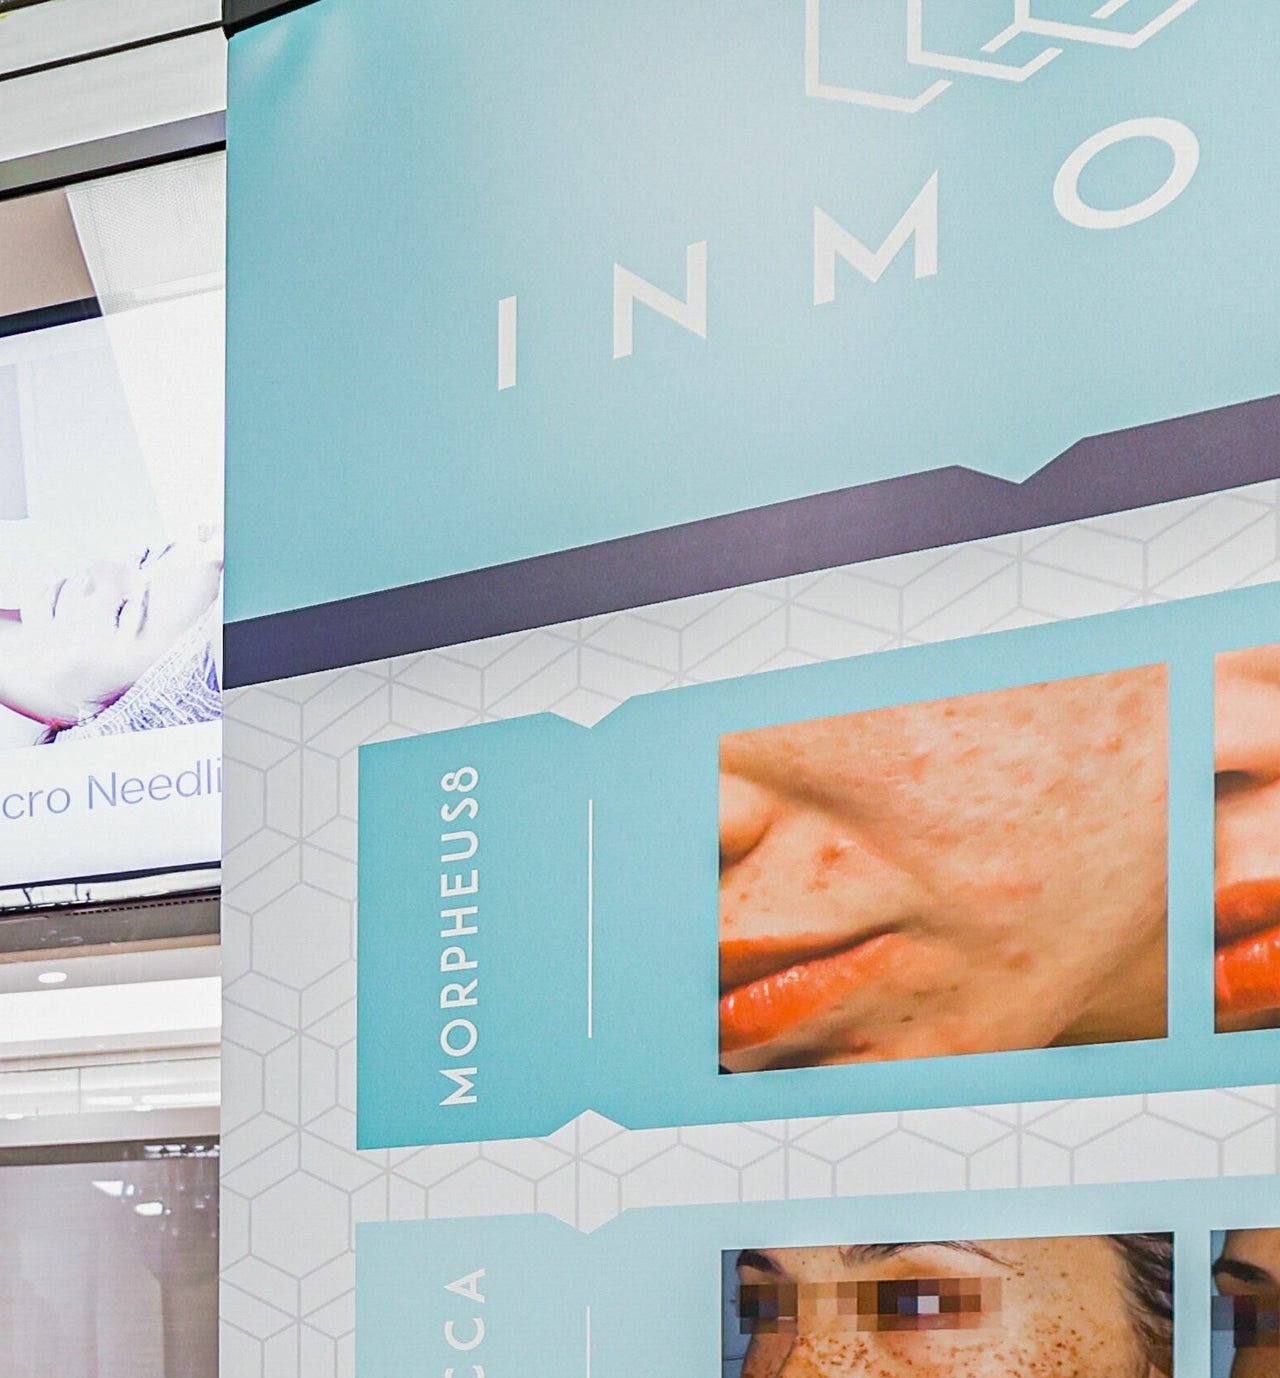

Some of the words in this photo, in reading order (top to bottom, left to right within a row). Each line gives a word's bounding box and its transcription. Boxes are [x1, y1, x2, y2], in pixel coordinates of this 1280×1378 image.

[497, 116, 1200, 391] INMO
[87, 757, 223, 810] Needli
[440, 765, 480, 1107] MORPHEUS8
